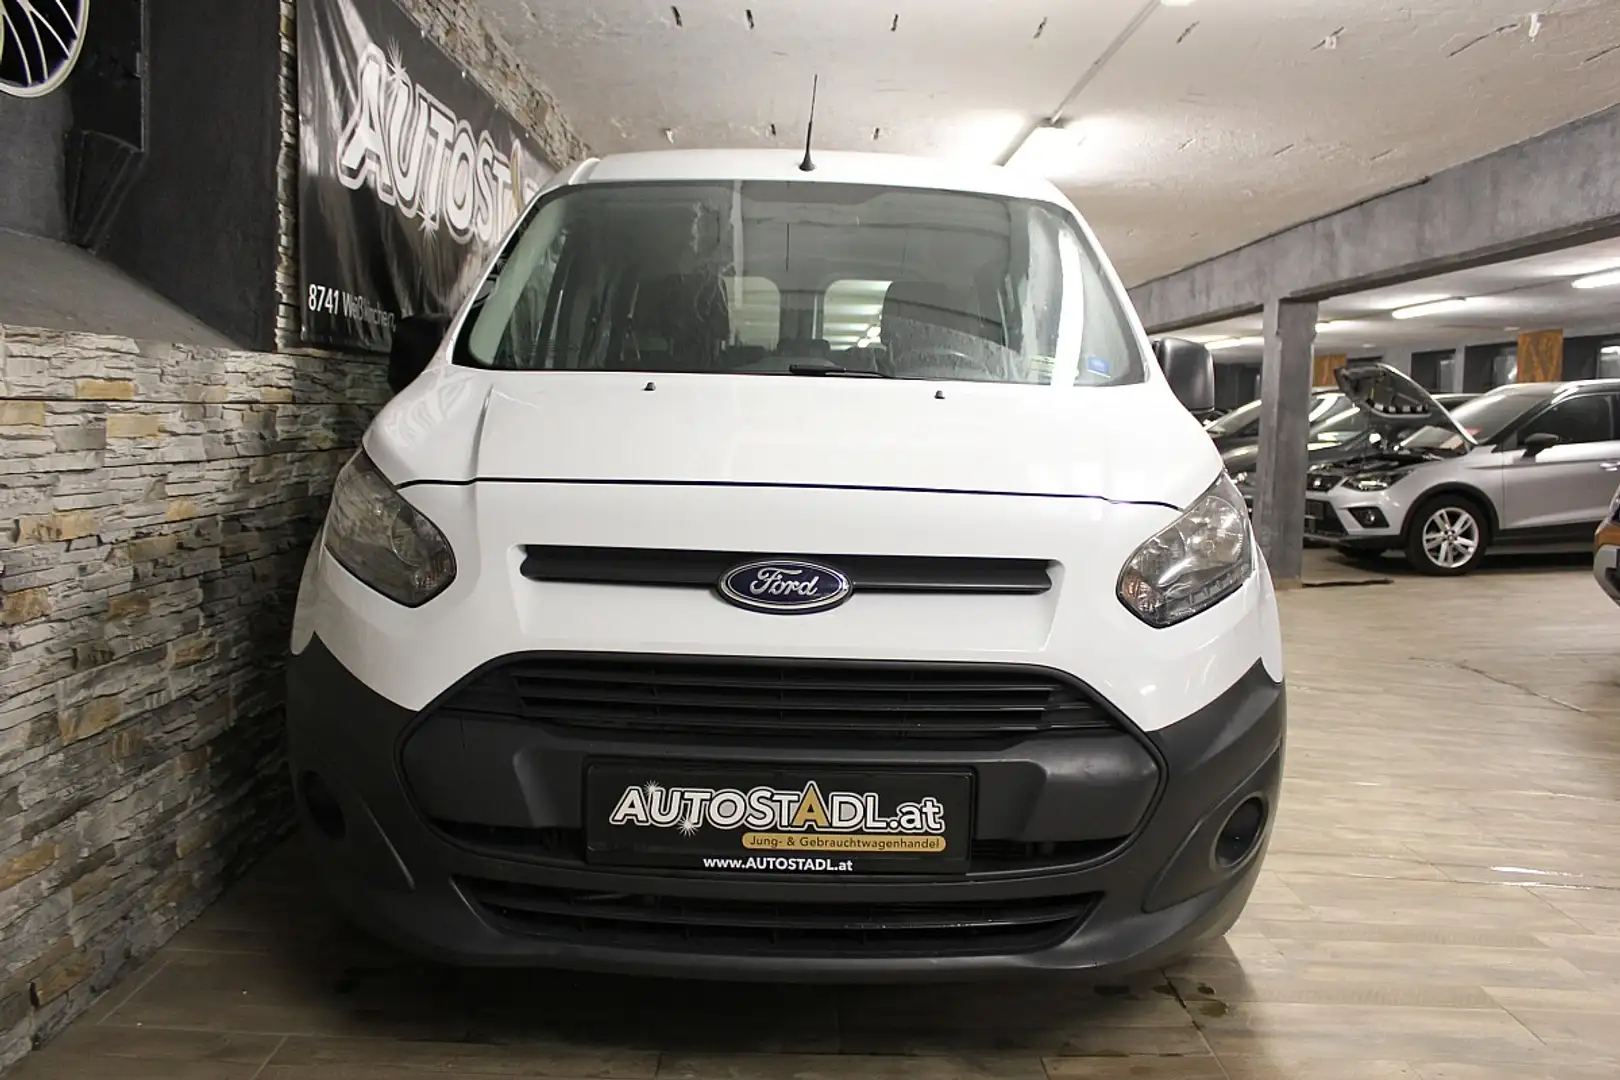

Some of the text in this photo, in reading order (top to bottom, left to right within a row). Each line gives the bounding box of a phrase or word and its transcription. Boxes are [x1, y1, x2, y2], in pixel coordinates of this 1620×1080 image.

[308, 284, 339, 315] 8741
[750, 567, 819, 595] Ford
[609, 780, 945, 833] AUTOSTADL.at
[749, 835, 940, 851] Jung- & Gebrauchtwagenhandel
[703, 857, 853, 871] www.AUTOSTADL.at
